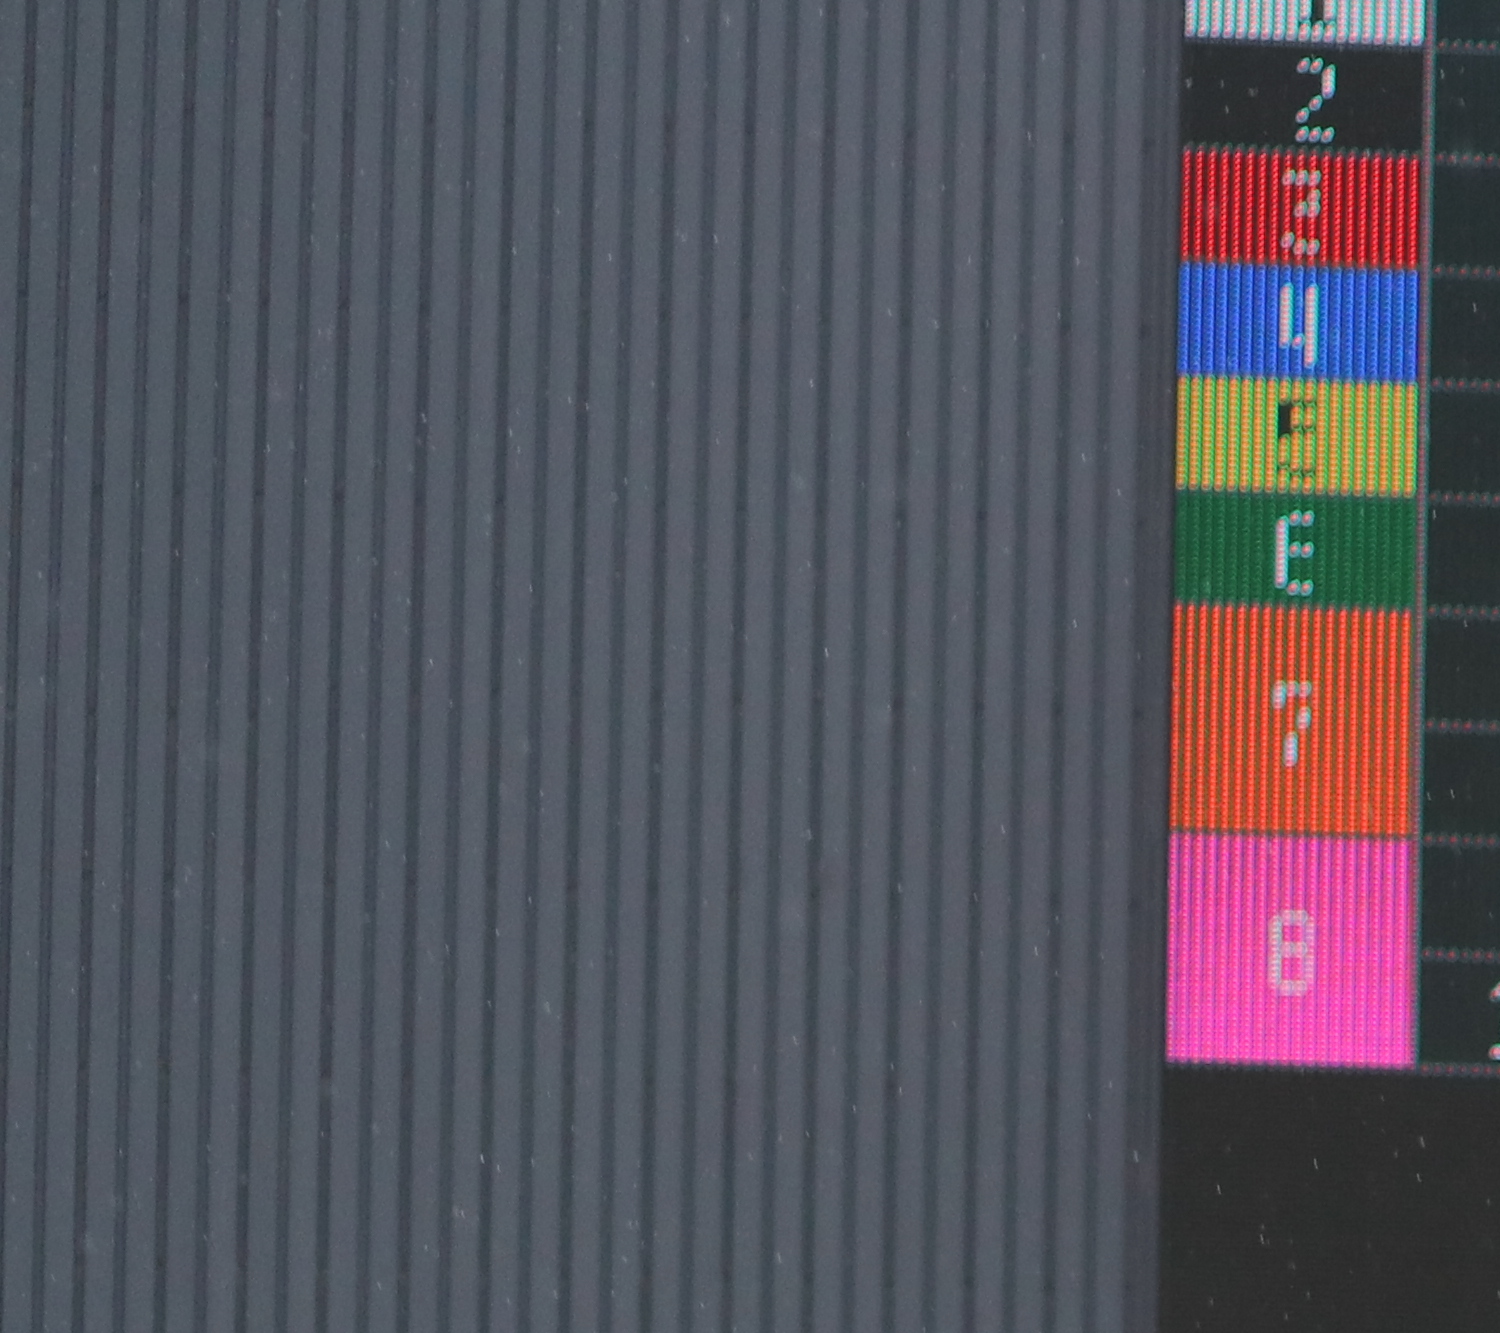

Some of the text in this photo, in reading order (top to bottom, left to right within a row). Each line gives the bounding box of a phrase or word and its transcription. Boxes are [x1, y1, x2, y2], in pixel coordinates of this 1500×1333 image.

[1296, 56, 1337, 144] 2
[1279, 280, 1319, 367] 4
[1267, 908, 1316, 998] 8
